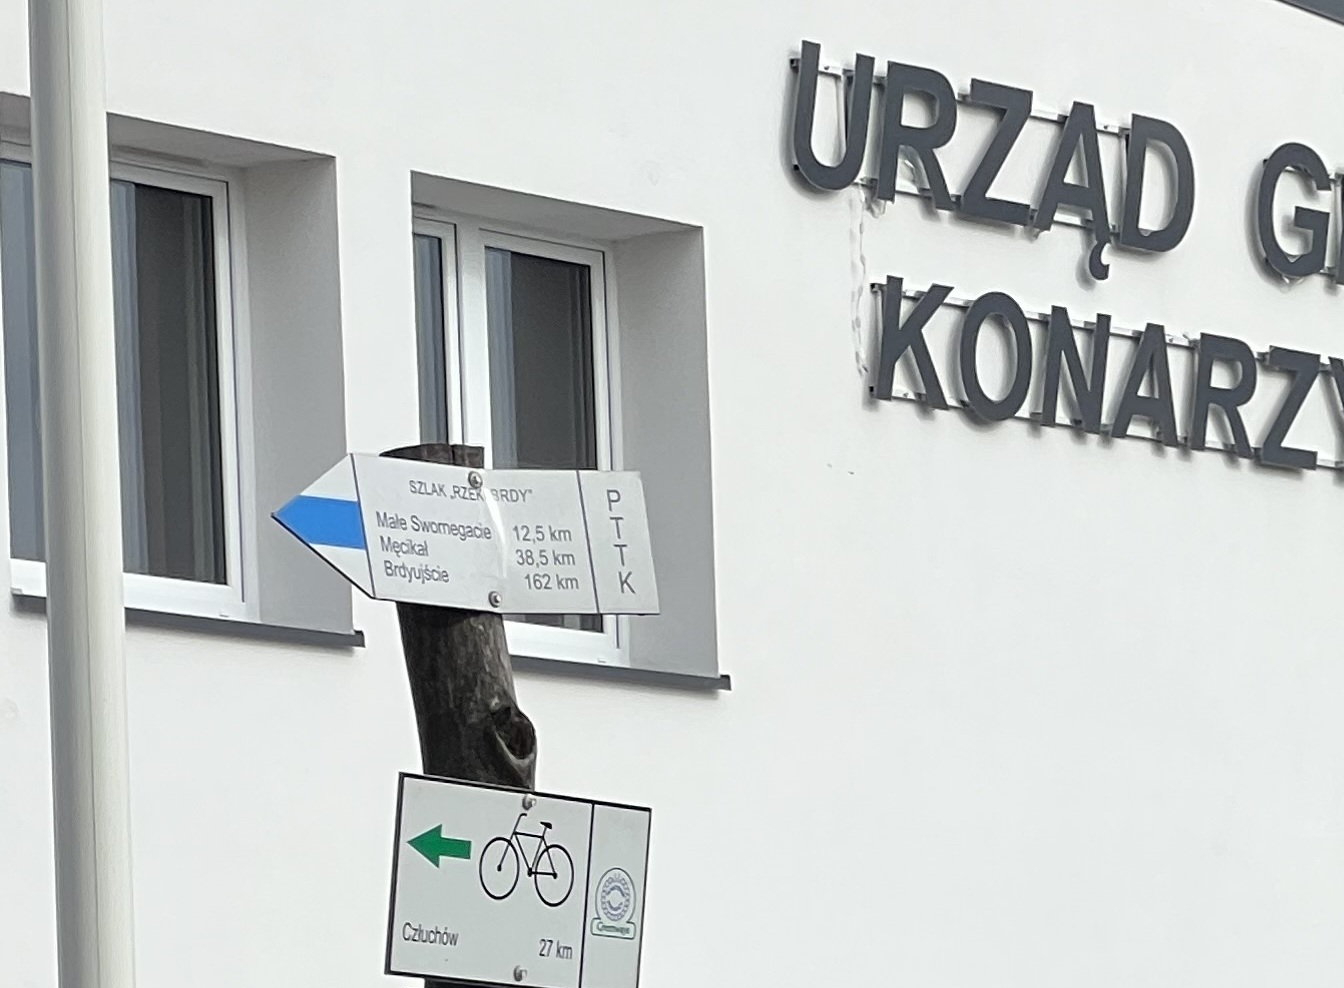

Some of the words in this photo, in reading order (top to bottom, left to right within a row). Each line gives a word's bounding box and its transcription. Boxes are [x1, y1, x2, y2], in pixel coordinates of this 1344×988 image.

[792, 39, 1196, 281] URZĄD
[409, 480, 447, 498] SZLAK
[376, 511, 408, 530] Małe
[512, 525, 545, 544] 12,5
[548, 525, 573, 542] km
[516, 549, 549, 568] 38,5
[552, 550, 576, 566] km
[384, 560, 449, 584] Brdyujście
[524, 573, 552, 590] 162
[556, 574, 579, 590] km
[402, 922, 459, 946] Człuchów
[539, 938, 554, 957] 27
[556, 940, 573, 959] km
